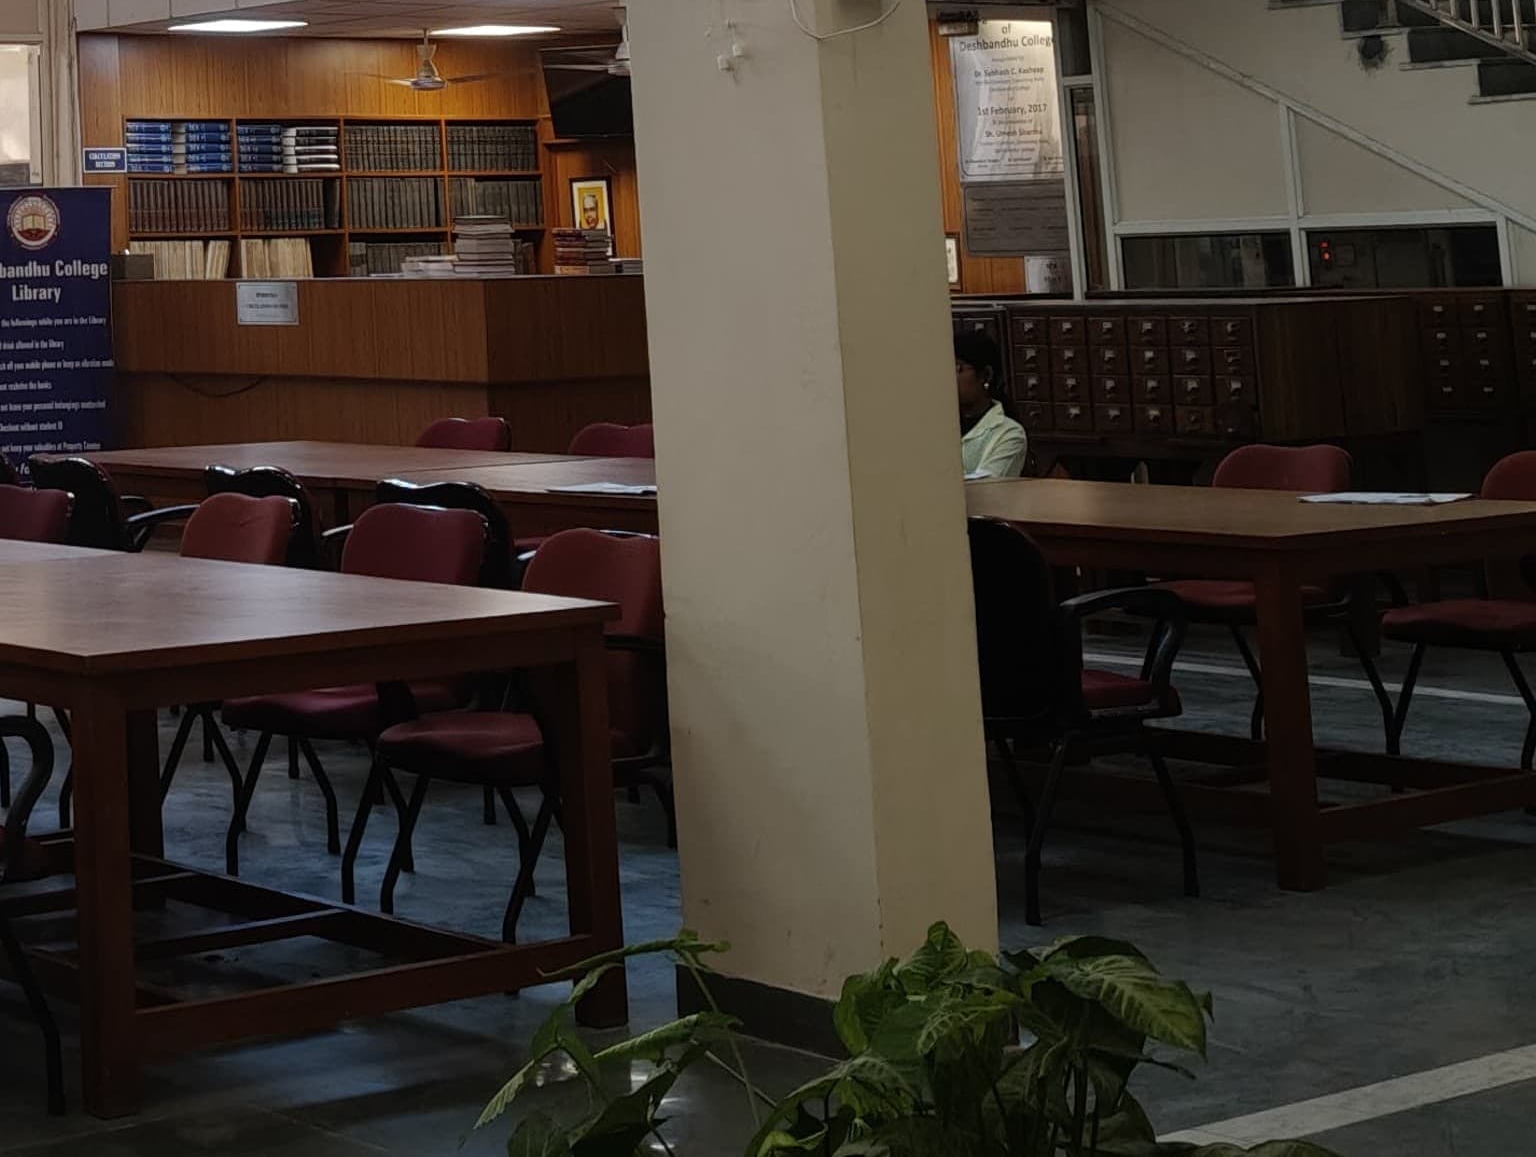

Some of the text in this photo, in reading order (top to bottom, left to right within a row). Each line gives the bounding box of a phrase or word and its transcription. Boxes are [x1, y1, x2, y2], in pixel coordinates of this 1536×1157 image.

[1001, 23, 1012, 34] of
[959, 33, 1054, 52] Deshbandhu Colleg
[1027, 103, 1048, 113] 2017
[55, 259, 109, 280] College
[12, 284, 62, 303] Library
